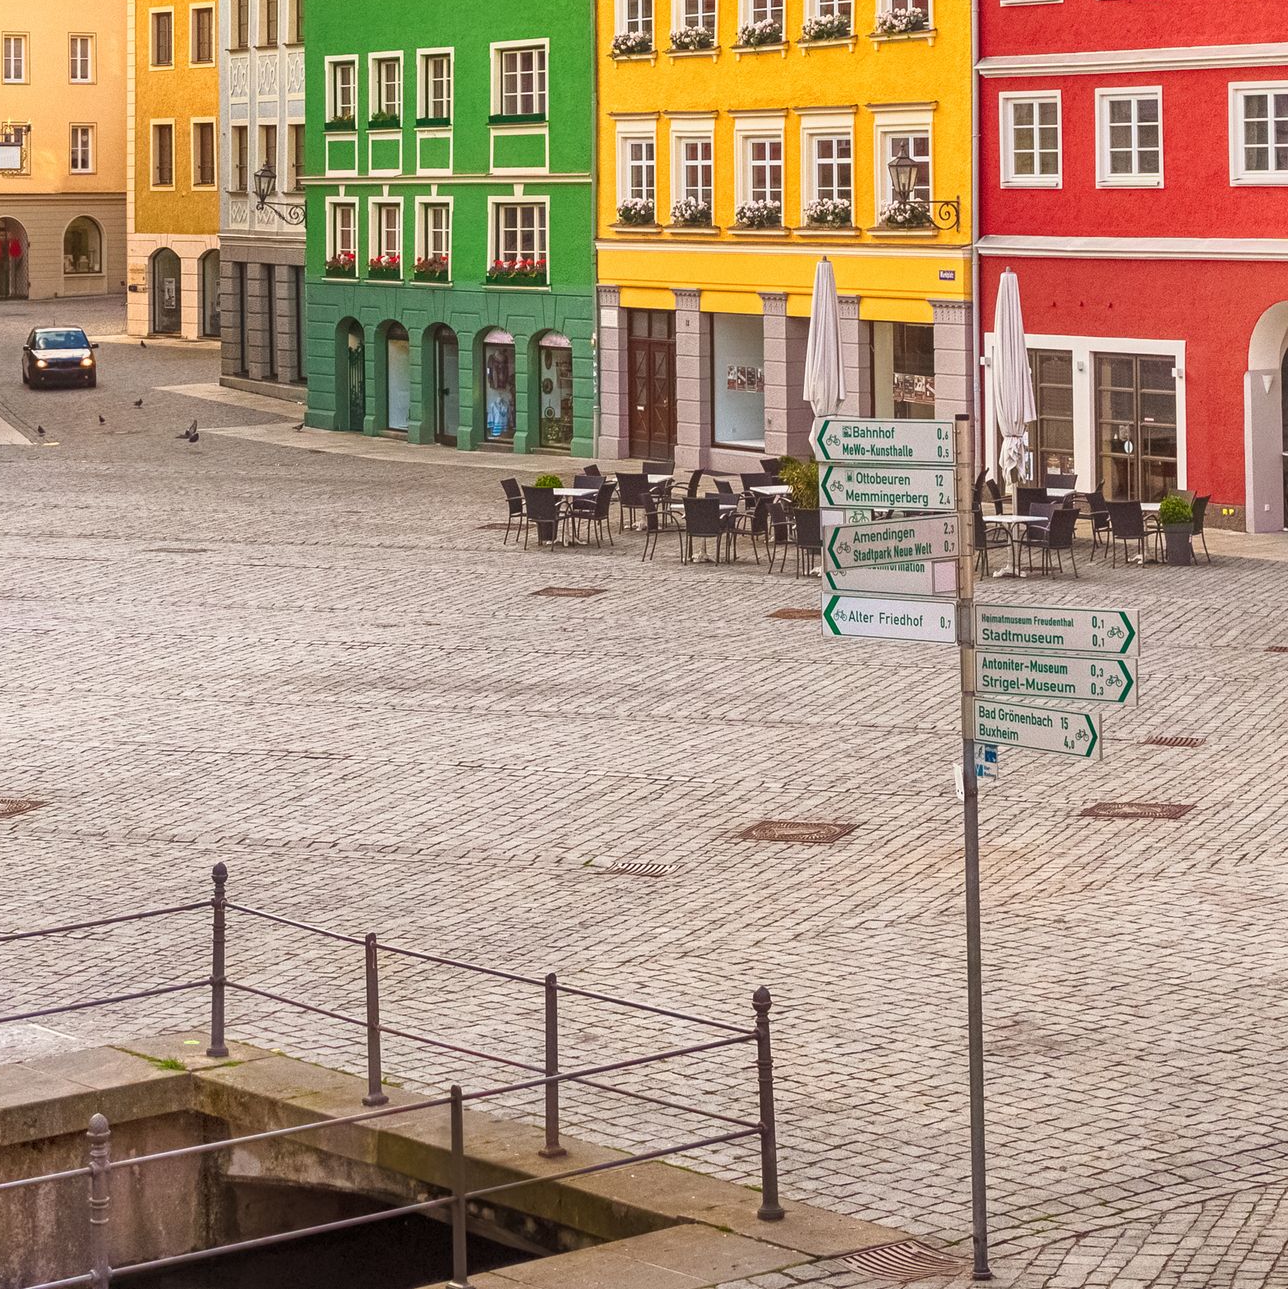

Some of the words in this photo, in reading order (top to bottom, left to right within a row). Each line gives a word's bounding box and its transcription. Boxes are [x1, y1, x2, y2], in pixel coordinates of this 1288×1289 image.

[853, 426, 895, 439] Bahnhof
[843, 444, 913, 457] MeWo-Kunsthalle
[856, 472, 911, 485] Ottobeuren
[935, 475, 943, 487] 12
[846, 490, 929, 507] Memmingerberg
[853, 528, 915, 544] Amendingen
[854, 547, 892, 563] Stadtpark
[894, 546, 913, 557] Neue
[915, 543, 932, 555] Welt
[849, 610, 874, 623] Alter
[879, 612, 923, 627] Friedhof
[981, 613, 1032, 625] Heimatmuseum
[1034, 616, 1074, 628] Freudenthal
[982, 628, 1064, 645] Stadtmuseum
[982, 657, 1068, 675] Antoniter-Museum
[982, 674, 1076, 693] Strigel-Museum
[978, 706, 996, 719] Bad
[998, 708, 1053, 728] Grönenbach
[1060, 717, 1069, 730] 15
[979, 723, 1019, 741] Buxheim
